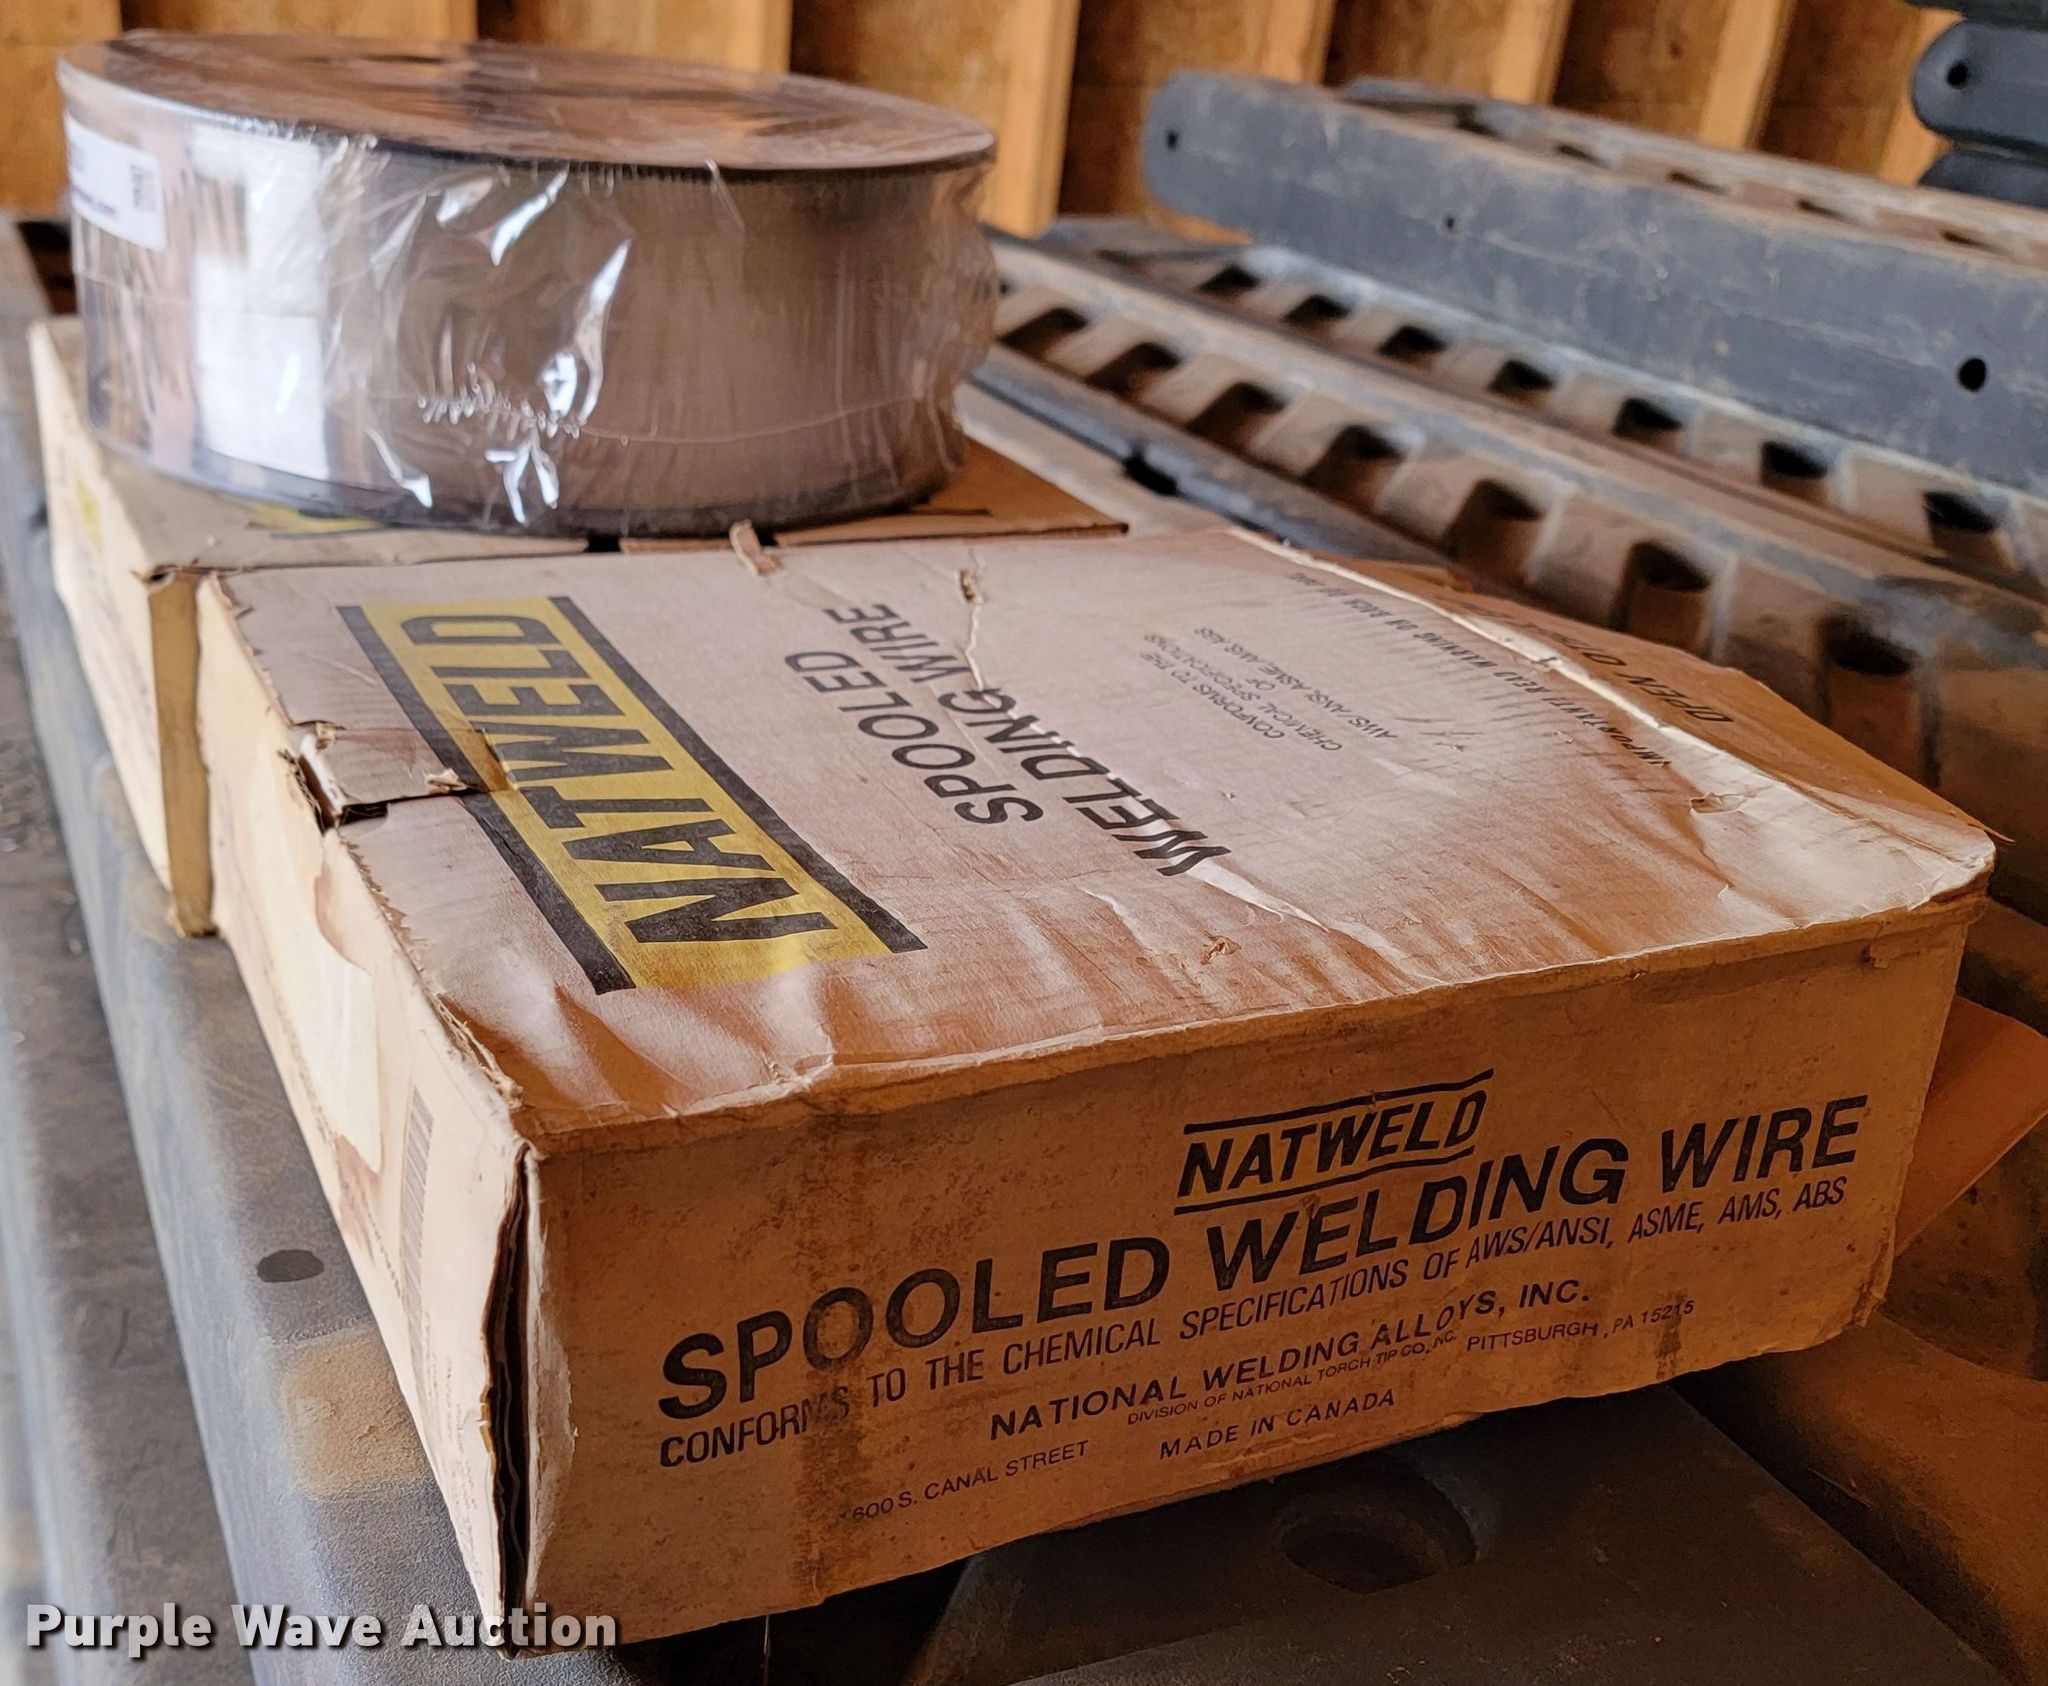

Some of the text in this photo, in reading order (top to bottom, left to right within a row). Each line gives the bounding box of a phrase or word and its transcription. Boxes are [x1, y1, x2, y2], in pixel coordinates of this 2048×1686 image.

[784, 651, 1044, 824] SPOOLED
[823, 604, 1231, 876] WELDING WIRE
[1494, 671, 1551, 693] READ
[1613, 672, 1734, 722] OPEN
[402, 613, 837, 943] NATWELD
[1176, 1090, 1488, 1198] NATWELD
[658, 1094, 1868, 1420] SPOOLED WELDING WIRE
[660, 1176, 1848, 1467] CONFORMS TO THE CHEMICAL SPECIFICATIONS OF AWS/ANSI, ASME, AMS, ABS
[898, 1491, 918, 1508] S.
[924, 1466, 998, 1501] CANAL
[1005, 1440, 1089, 1477] STREET
[1612, 1314, 1634, 1333] PA
[1641, 1300, 1695, 1324] 15215
[990, 1279, 1590, 1441] NATIONAL WELDING ALLOYS, INC.
[1127, 1401, 1198, 1425] DIVISION
[1203, 1393, 1227, 1408] OF
[1231, 1375, 1313, 1402] NATIONAL
[1317, 1358, 1371, 1382] TORCH
[1376, 1350, 1398, 1364] TIP
[1159, 1388, 1396, 1460] MADE IN CANADA
